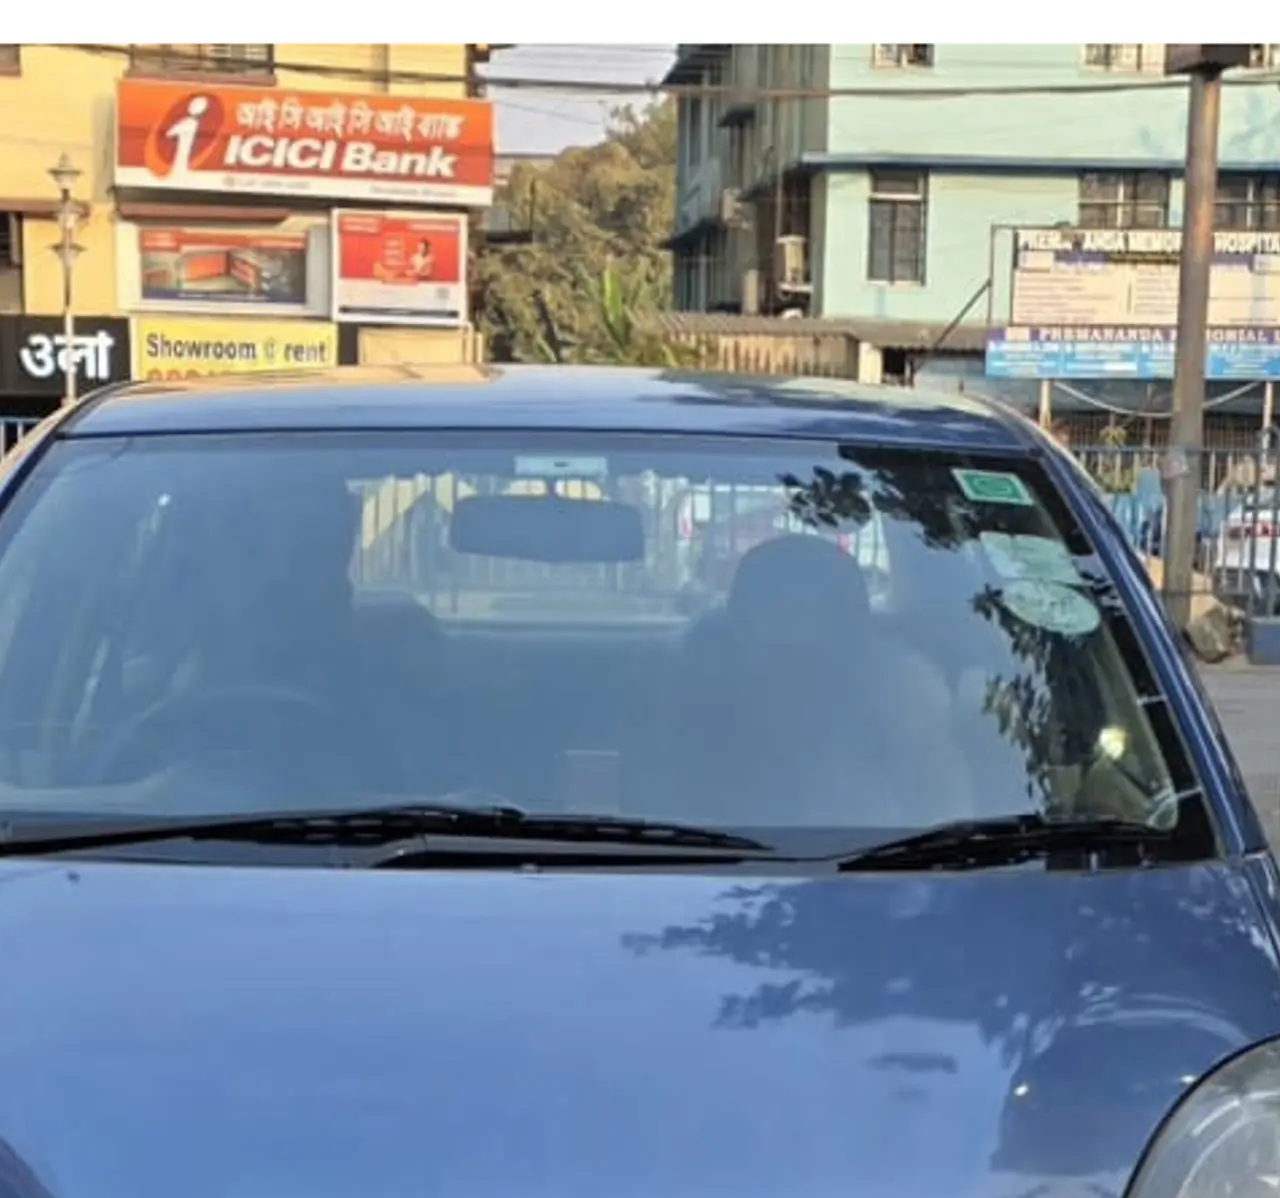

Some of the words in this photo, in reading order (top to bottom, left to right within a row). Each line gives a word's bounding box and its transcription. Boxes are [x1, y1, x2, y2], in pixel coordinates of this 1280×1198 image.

[223, 135, 338, 169] ICICI
[341, 140, 458, 178] Bank
[21, 330, 115, 378] ওলা
[146, 332, 257, 358] Showroom
[283, 340, 327, 363] rent
